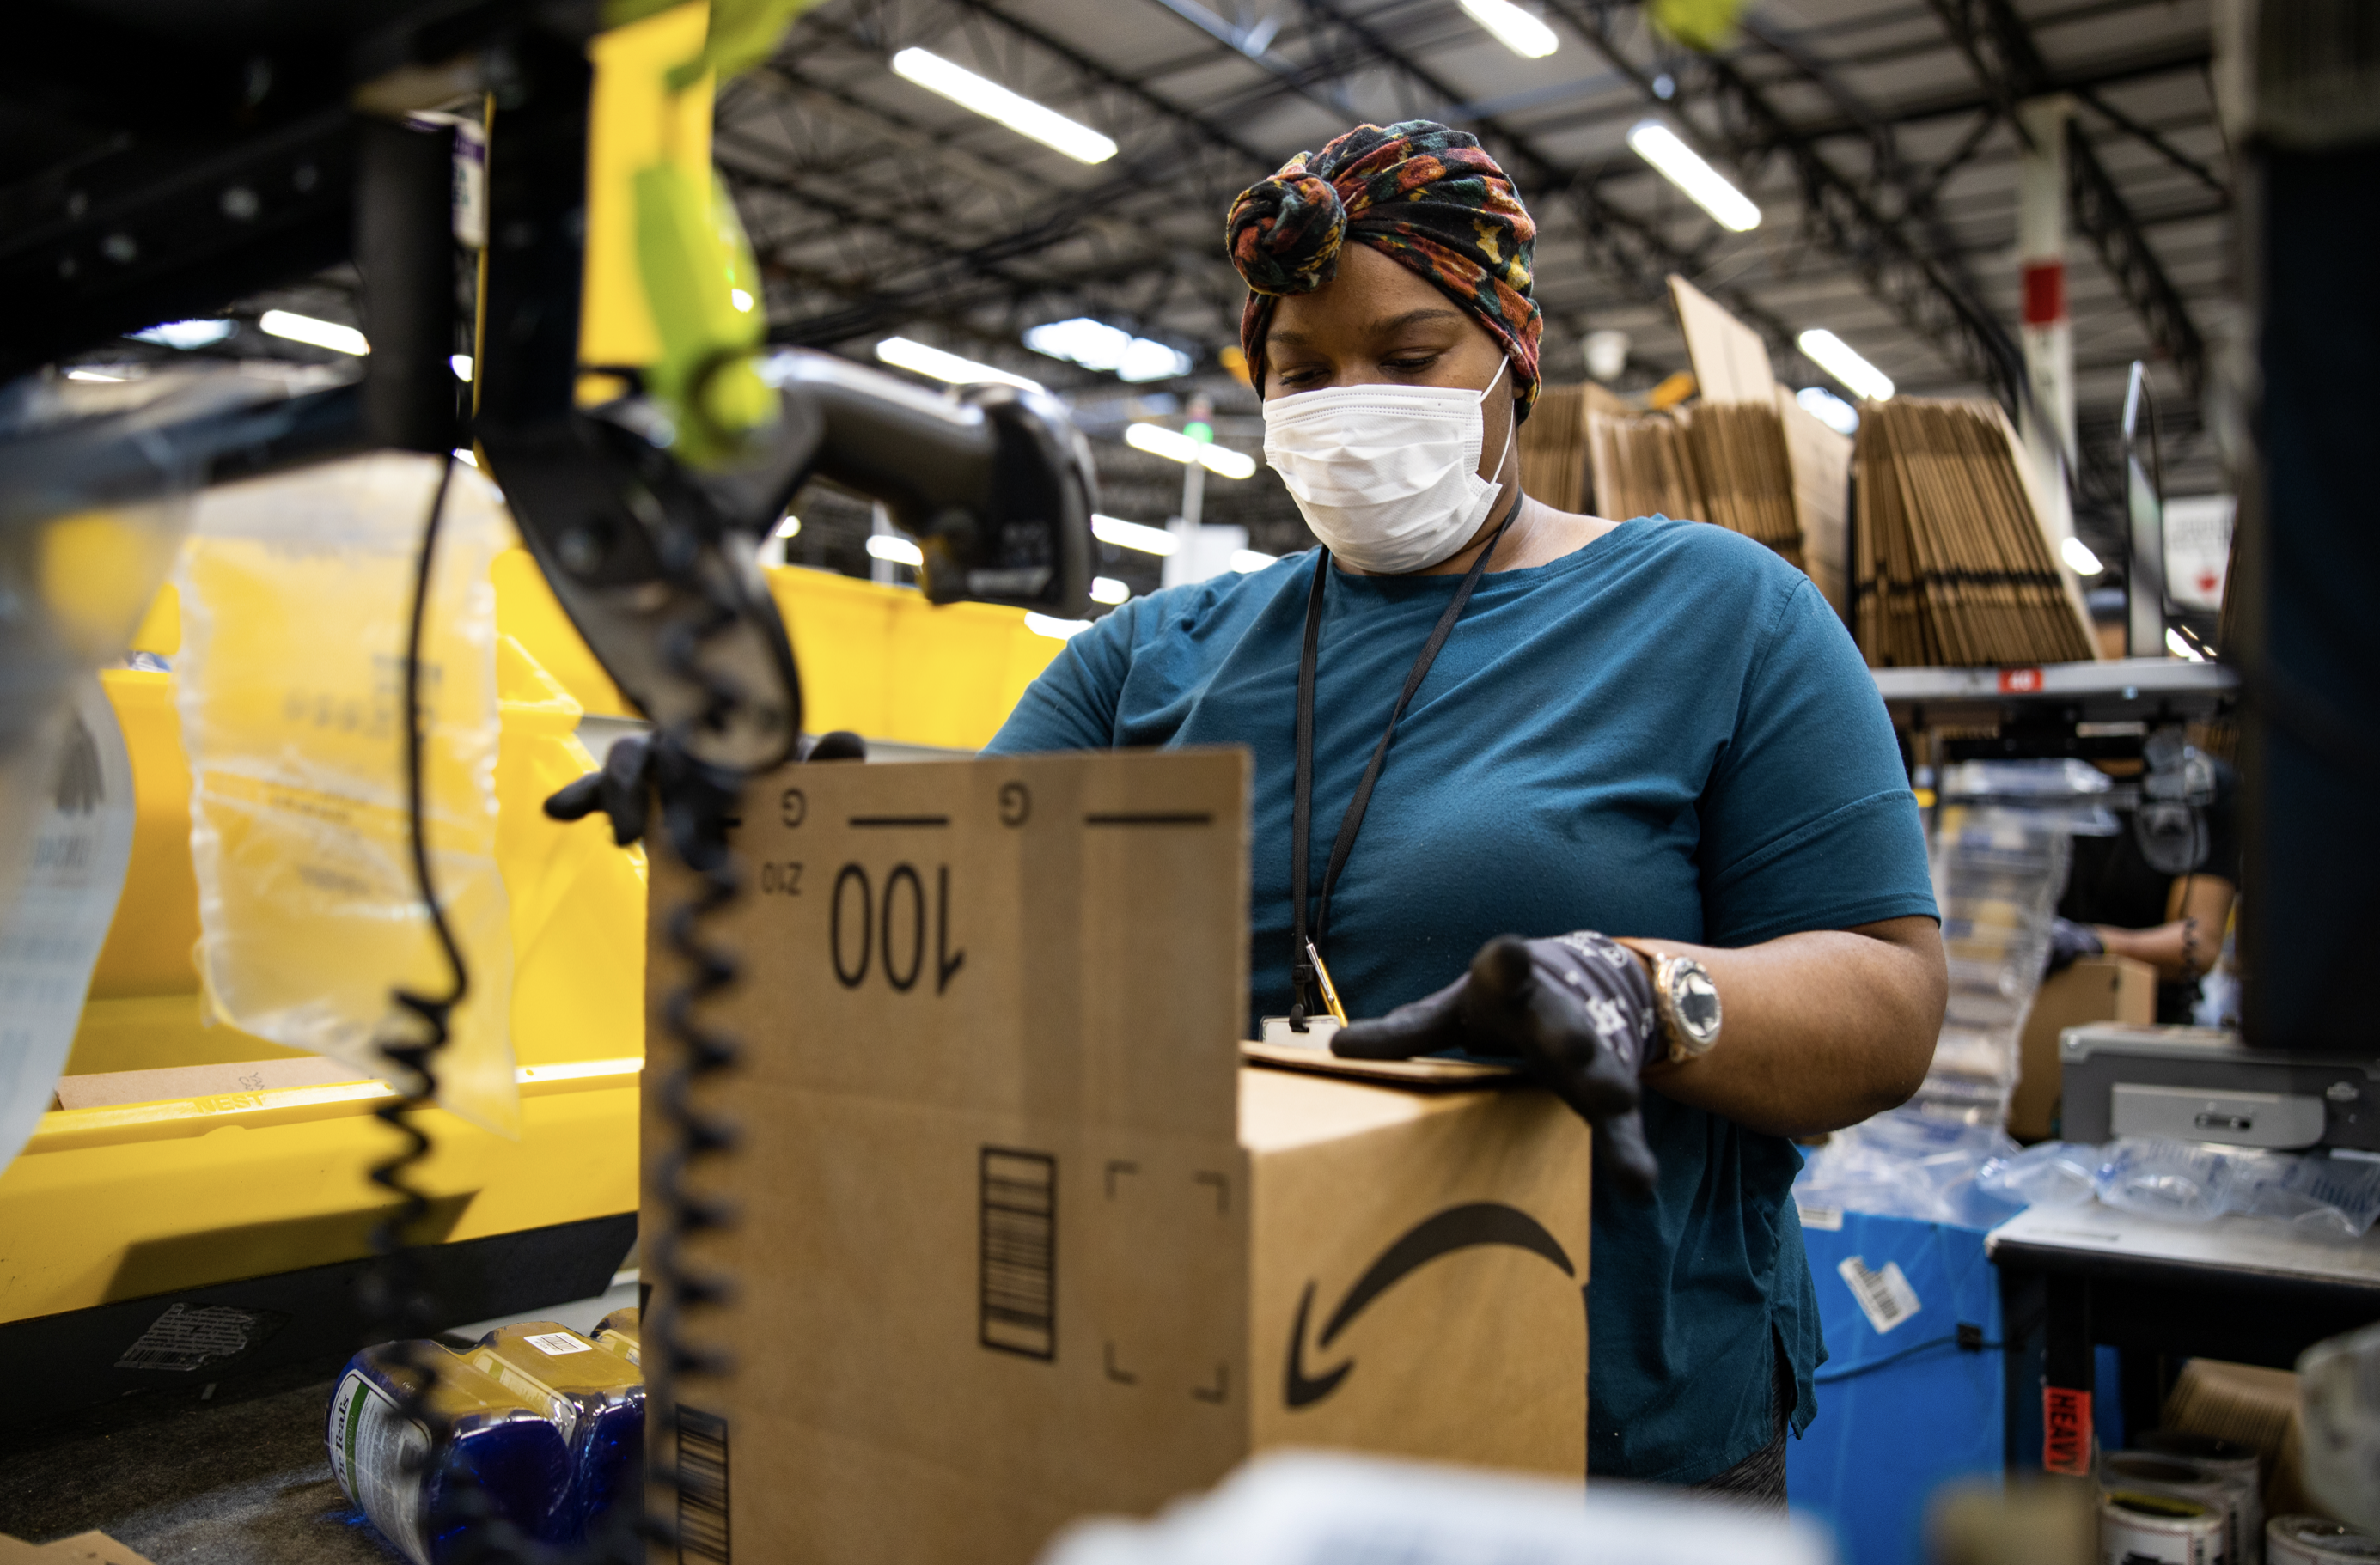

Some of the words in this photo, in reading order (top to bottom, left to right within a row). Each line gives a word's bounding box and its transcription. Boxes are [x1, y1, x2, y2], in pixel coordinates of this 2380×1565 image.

[782, 788, 806, 828] G
[998, 781, 1030, 828] G
[830, 862, 966, 996] 100
[193, 1093, 265, 1114] NEST
[2049, 1393, 2078, 1467] HEAVY
